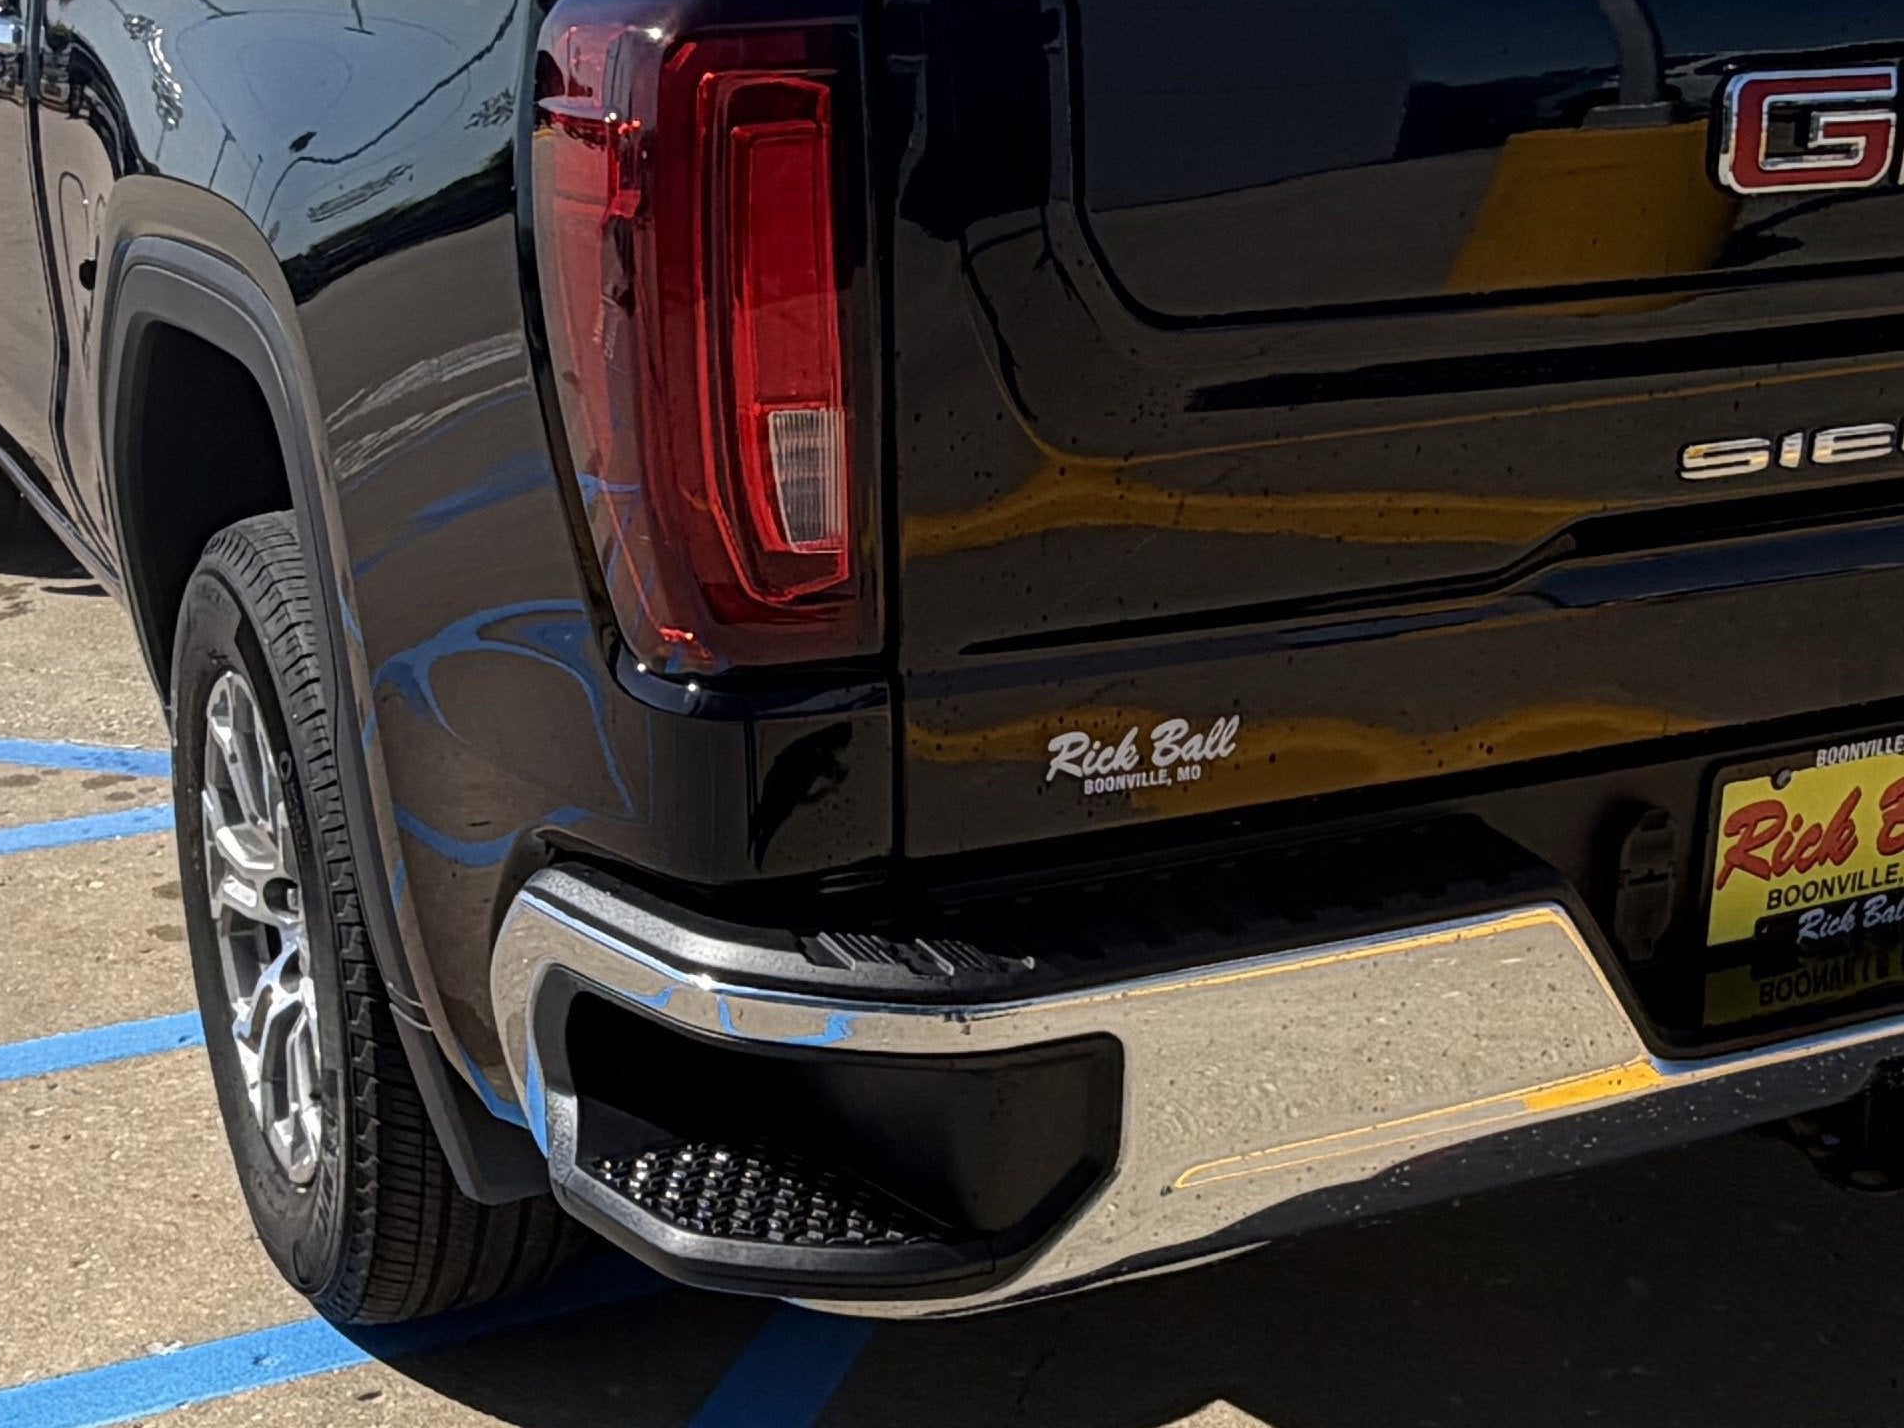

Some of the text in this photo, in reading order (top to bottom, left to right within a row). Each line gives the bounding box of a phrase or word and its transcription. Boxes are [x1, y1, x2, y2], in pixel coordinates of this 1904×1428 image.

[1046, 714, 1241, 782] Rick Ball
[1084, 764, 1202, 795] BOONVILLE, MO
[1715, 786, 1863, 890] Rick
[1766, 862, 1904, 910] BOONVILLE,
[1796, 900, 1858, 945] Rick
